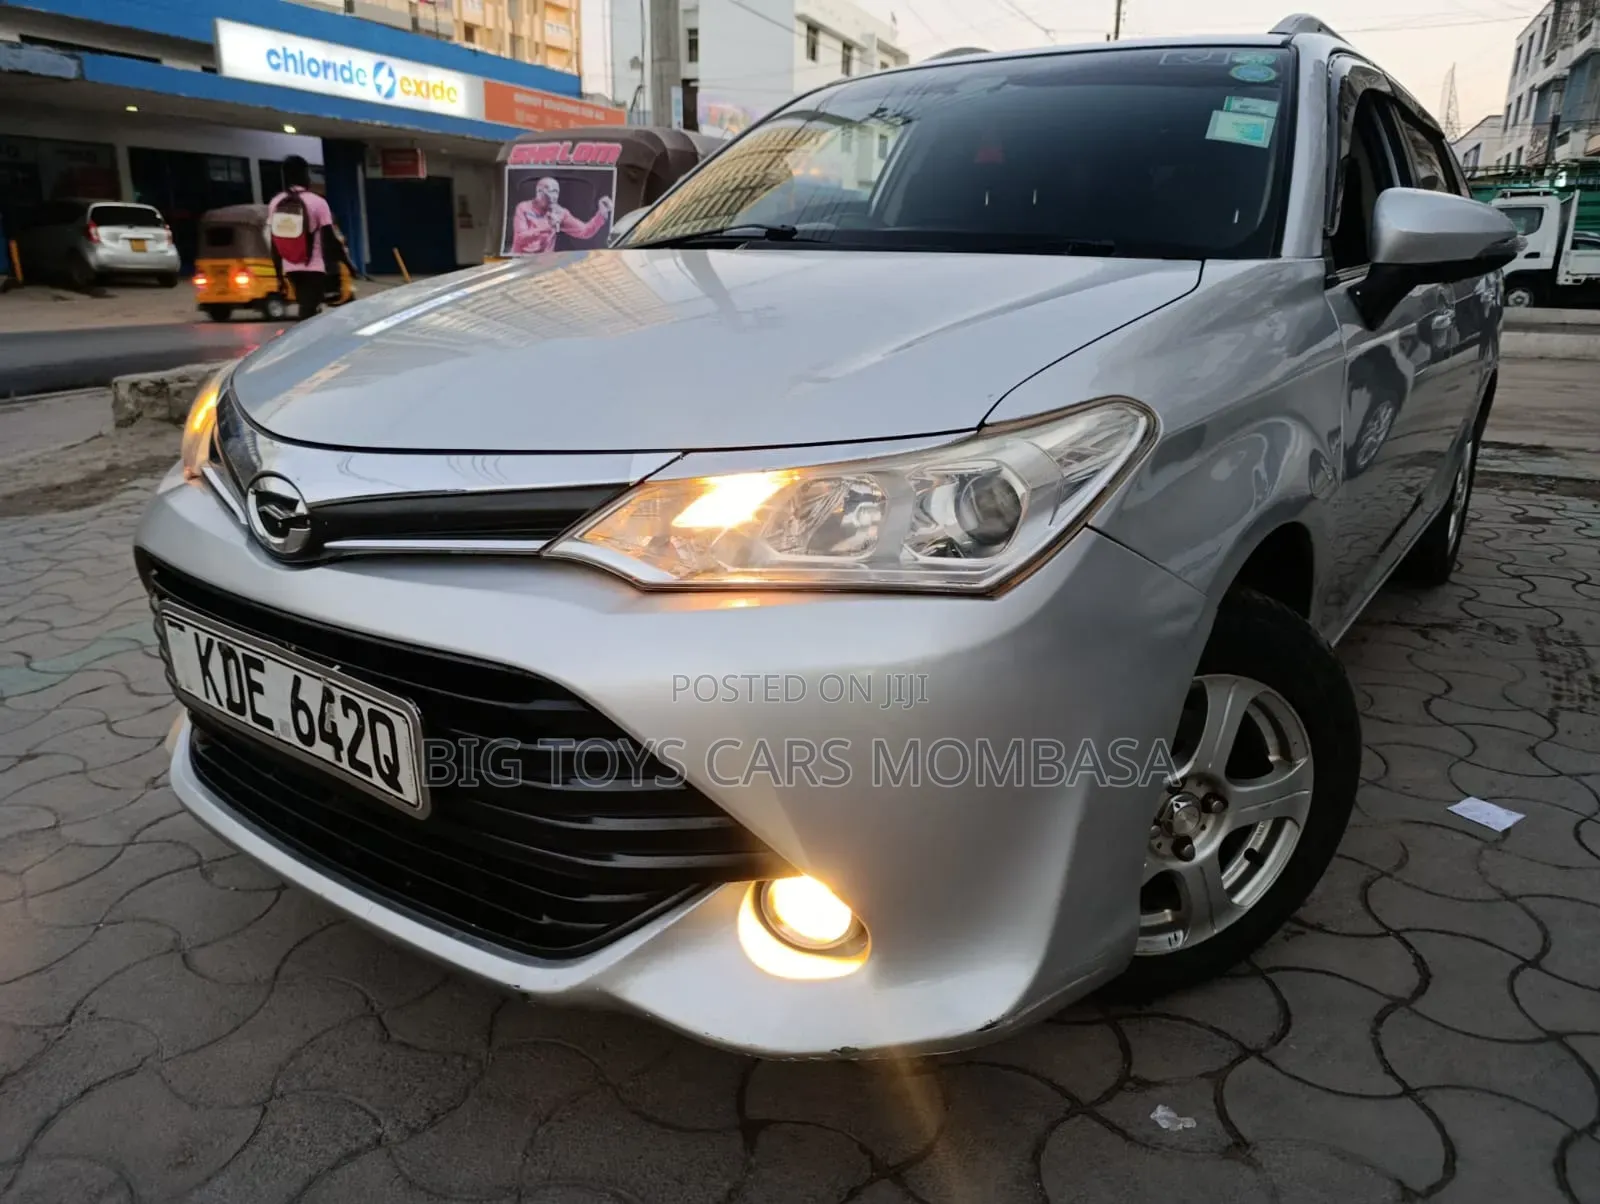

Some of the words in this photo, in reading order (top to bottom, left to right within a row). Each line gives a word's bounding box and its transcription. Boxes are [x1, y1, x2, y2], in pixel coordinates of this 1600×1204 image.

[266, 46, 368, 87] chloride
[400, 74, 457, 103] exide
[508, 141, 622, 165] SHALOM
[194, 632, 274, 731] KDE
[290, 674, 404, 795] 642Q
